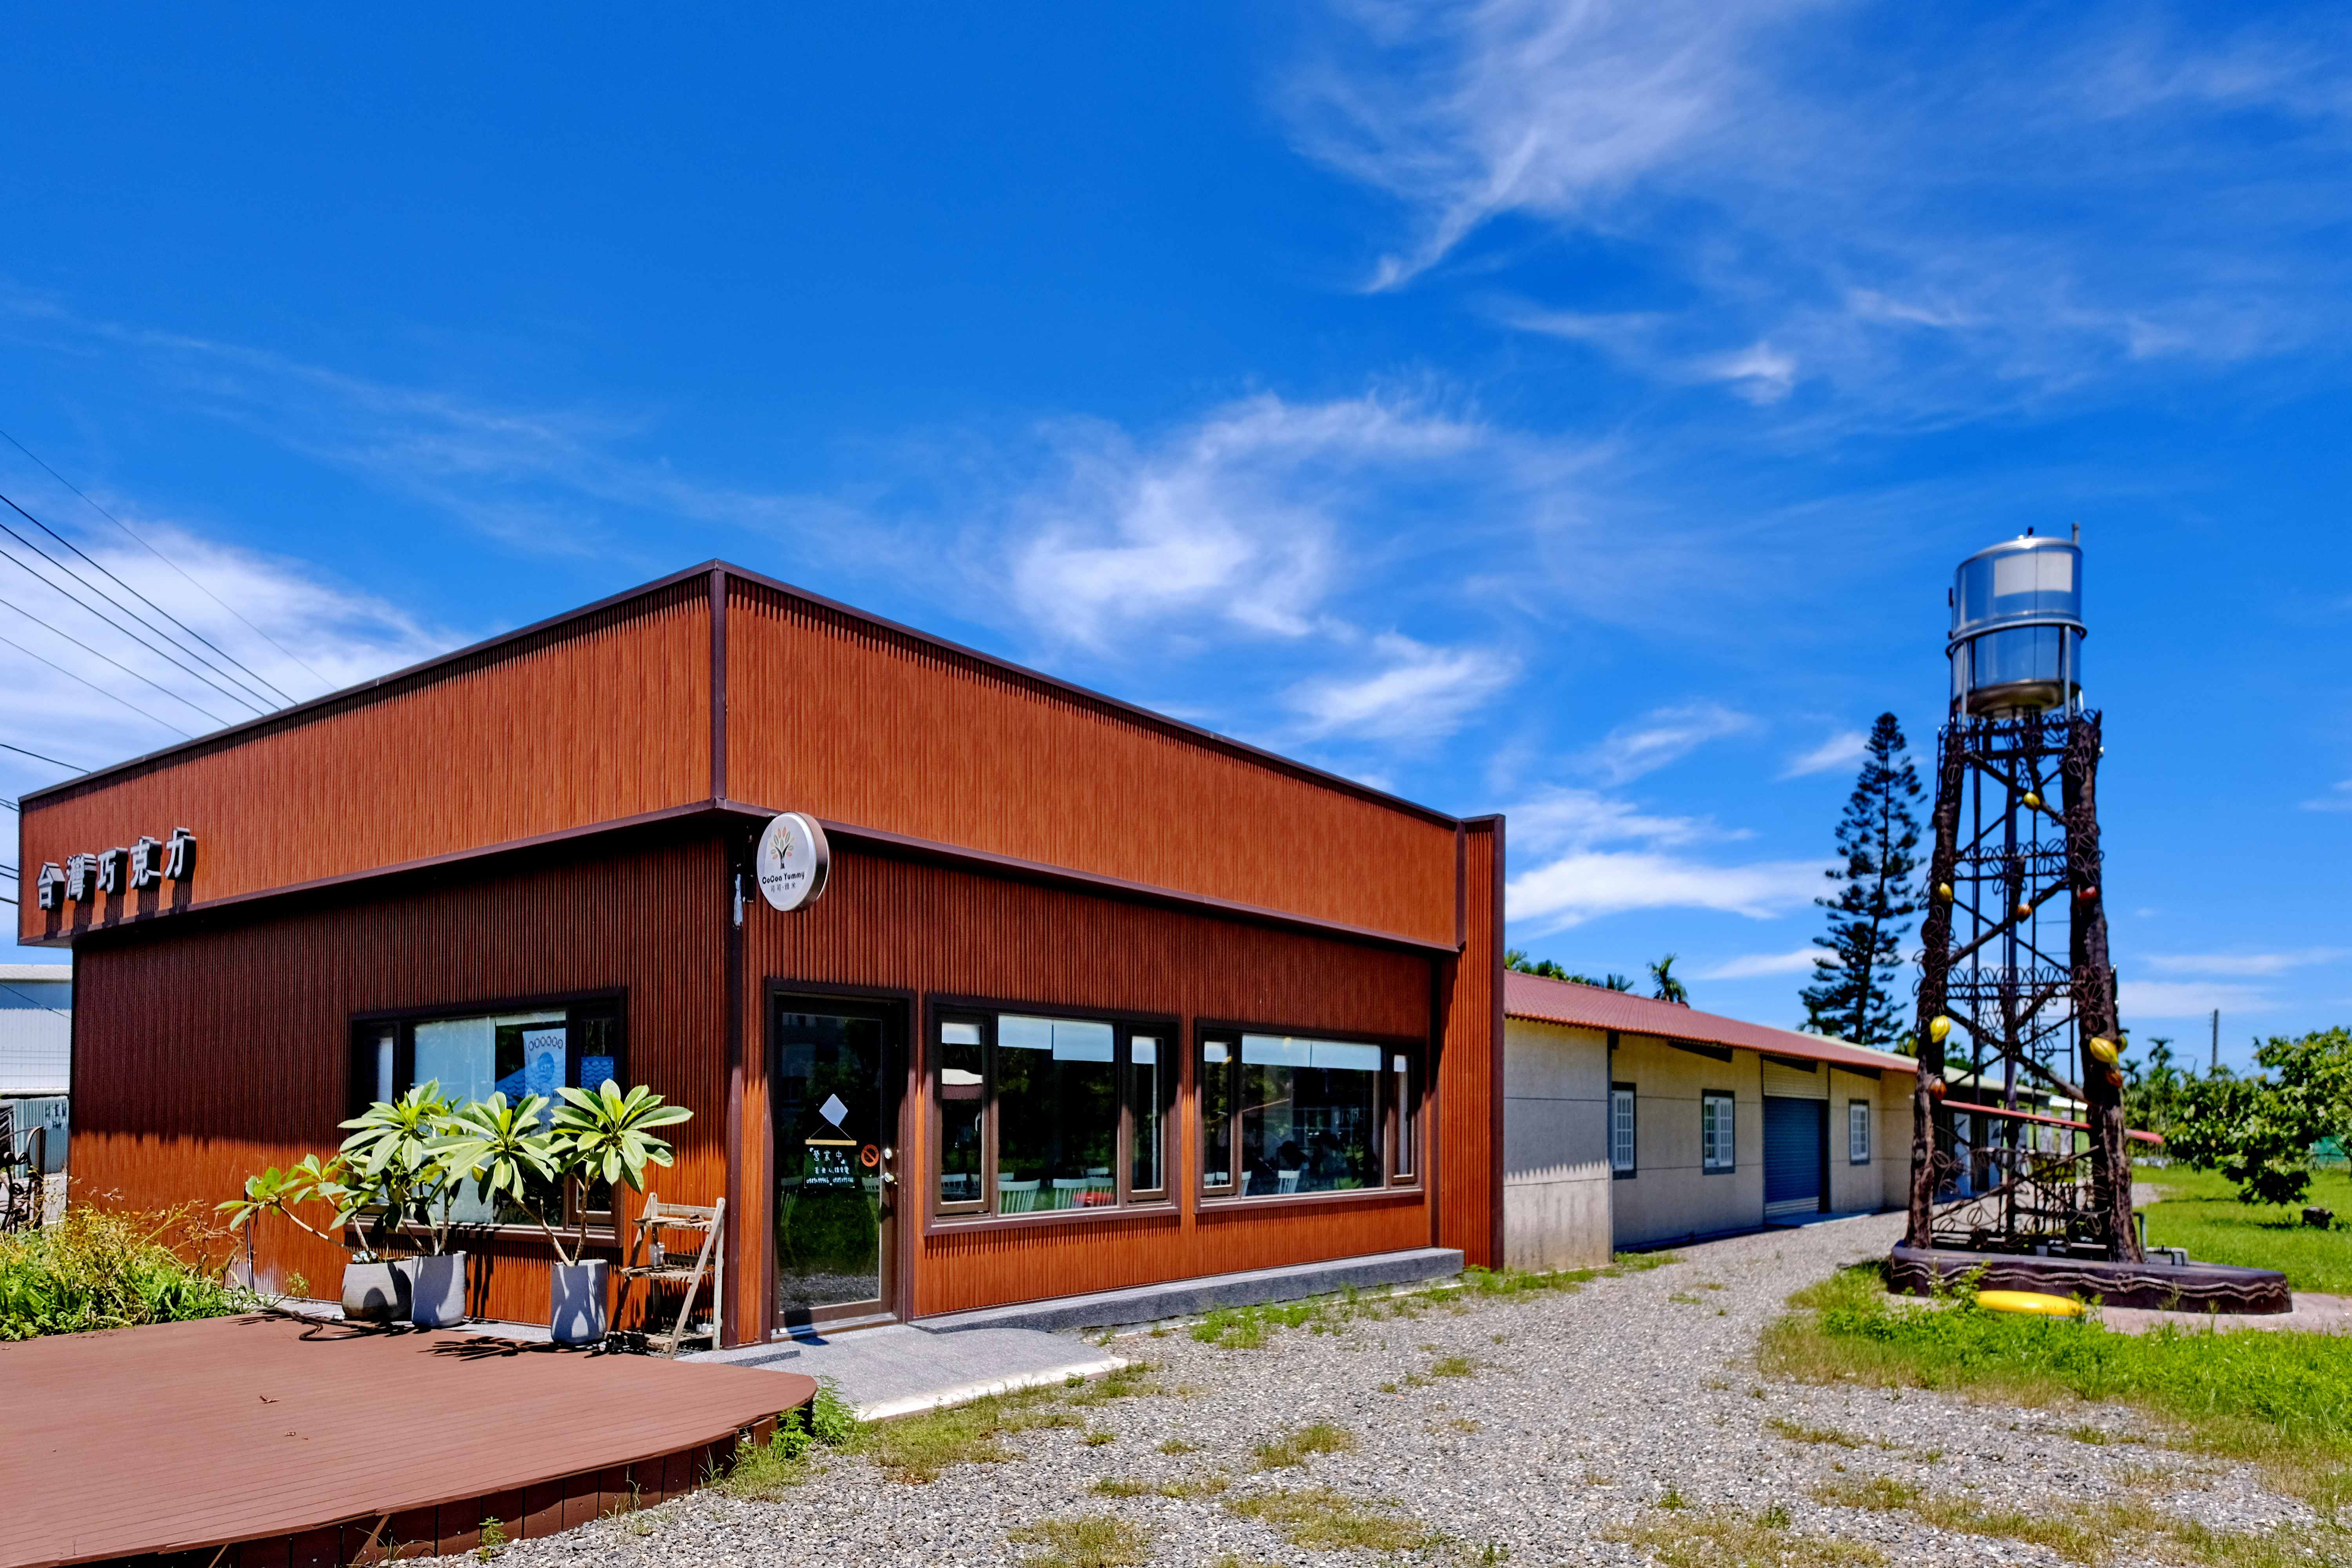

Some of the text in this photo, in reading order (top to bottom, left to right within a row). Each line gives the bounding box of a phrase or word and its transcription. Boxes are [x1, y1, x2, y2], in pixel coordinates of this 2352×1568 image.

[38, 827, 194, 909] 台灣巧克力
[762, 872, 804, 884] CoCoa Yummy
